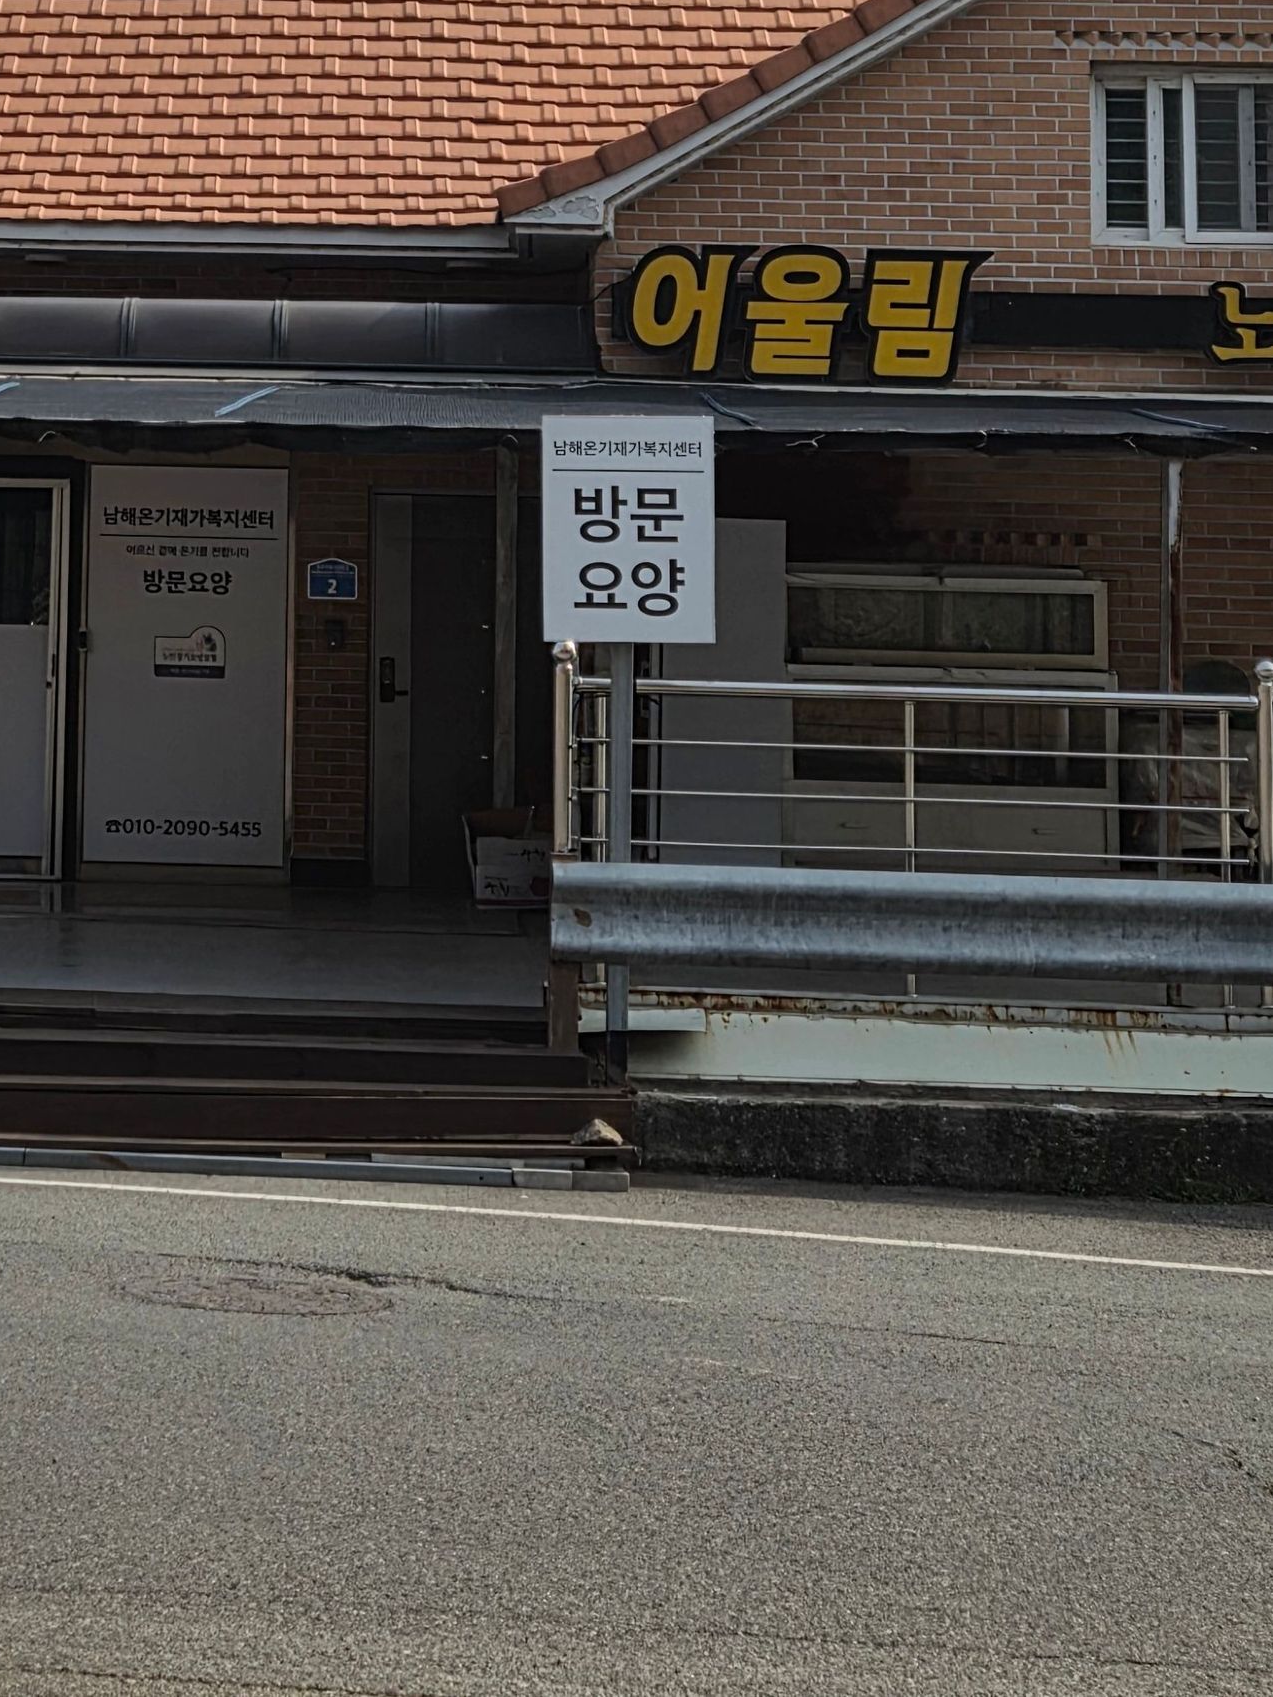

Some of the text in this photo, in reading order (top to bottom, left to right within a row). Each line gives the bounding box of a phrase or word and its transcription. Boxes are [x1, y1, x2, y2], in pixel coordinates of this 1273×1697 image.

[629, 251, 971, 380] 어울림
[553, 439, 704, 460] 남해온기재가복지센터
[103, 505, 275, 530] 남해온기재가복지센터
[573, 485, 686, 545] 방문
[142, 568, 234, 596] 방문요양
[326, 578, 338, 595] 2
[573, 559, 686, 618] 요양
